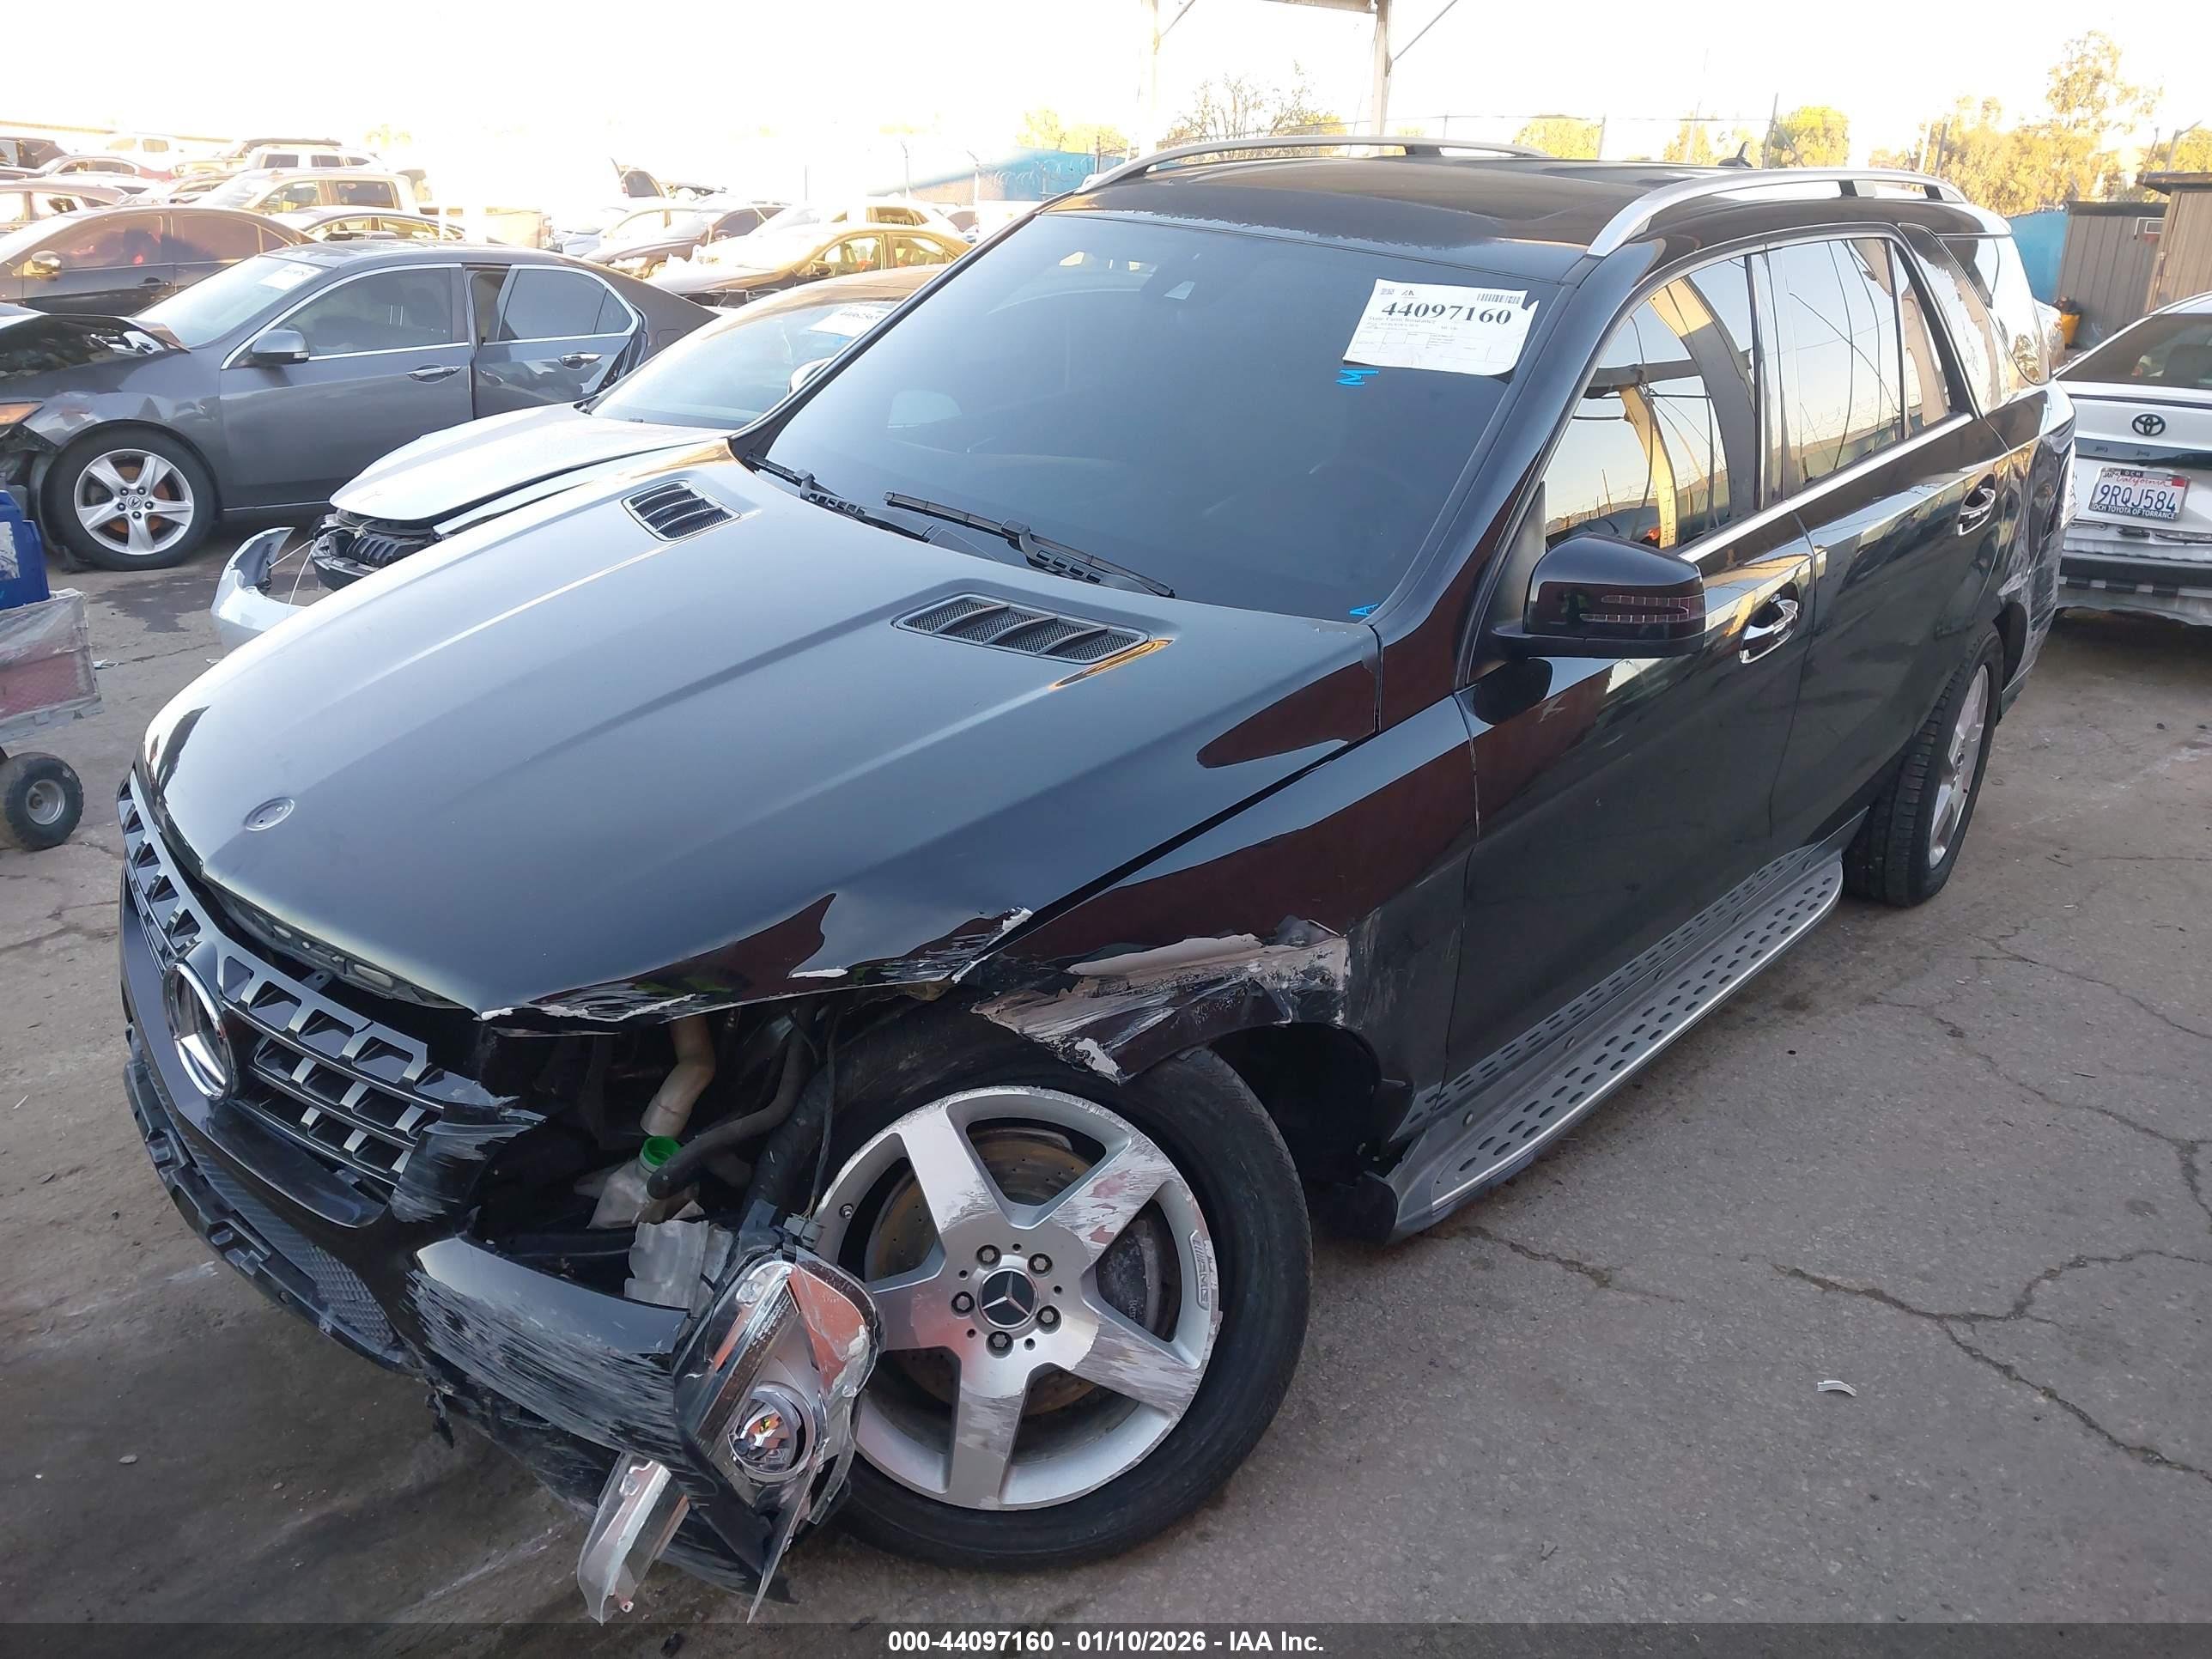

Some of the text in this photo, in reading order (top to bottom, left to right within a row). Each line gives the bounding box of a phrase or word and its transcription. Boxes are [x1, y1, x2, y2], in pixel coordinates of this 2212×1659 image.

[1381, 301, 1512, 325] 44097160
[2097, 484, 2176, 513] 9RQJ584
[2108, 505, 2131, 514] TOYOTA
[2142, 509, 2176, 520] TORRANCE
